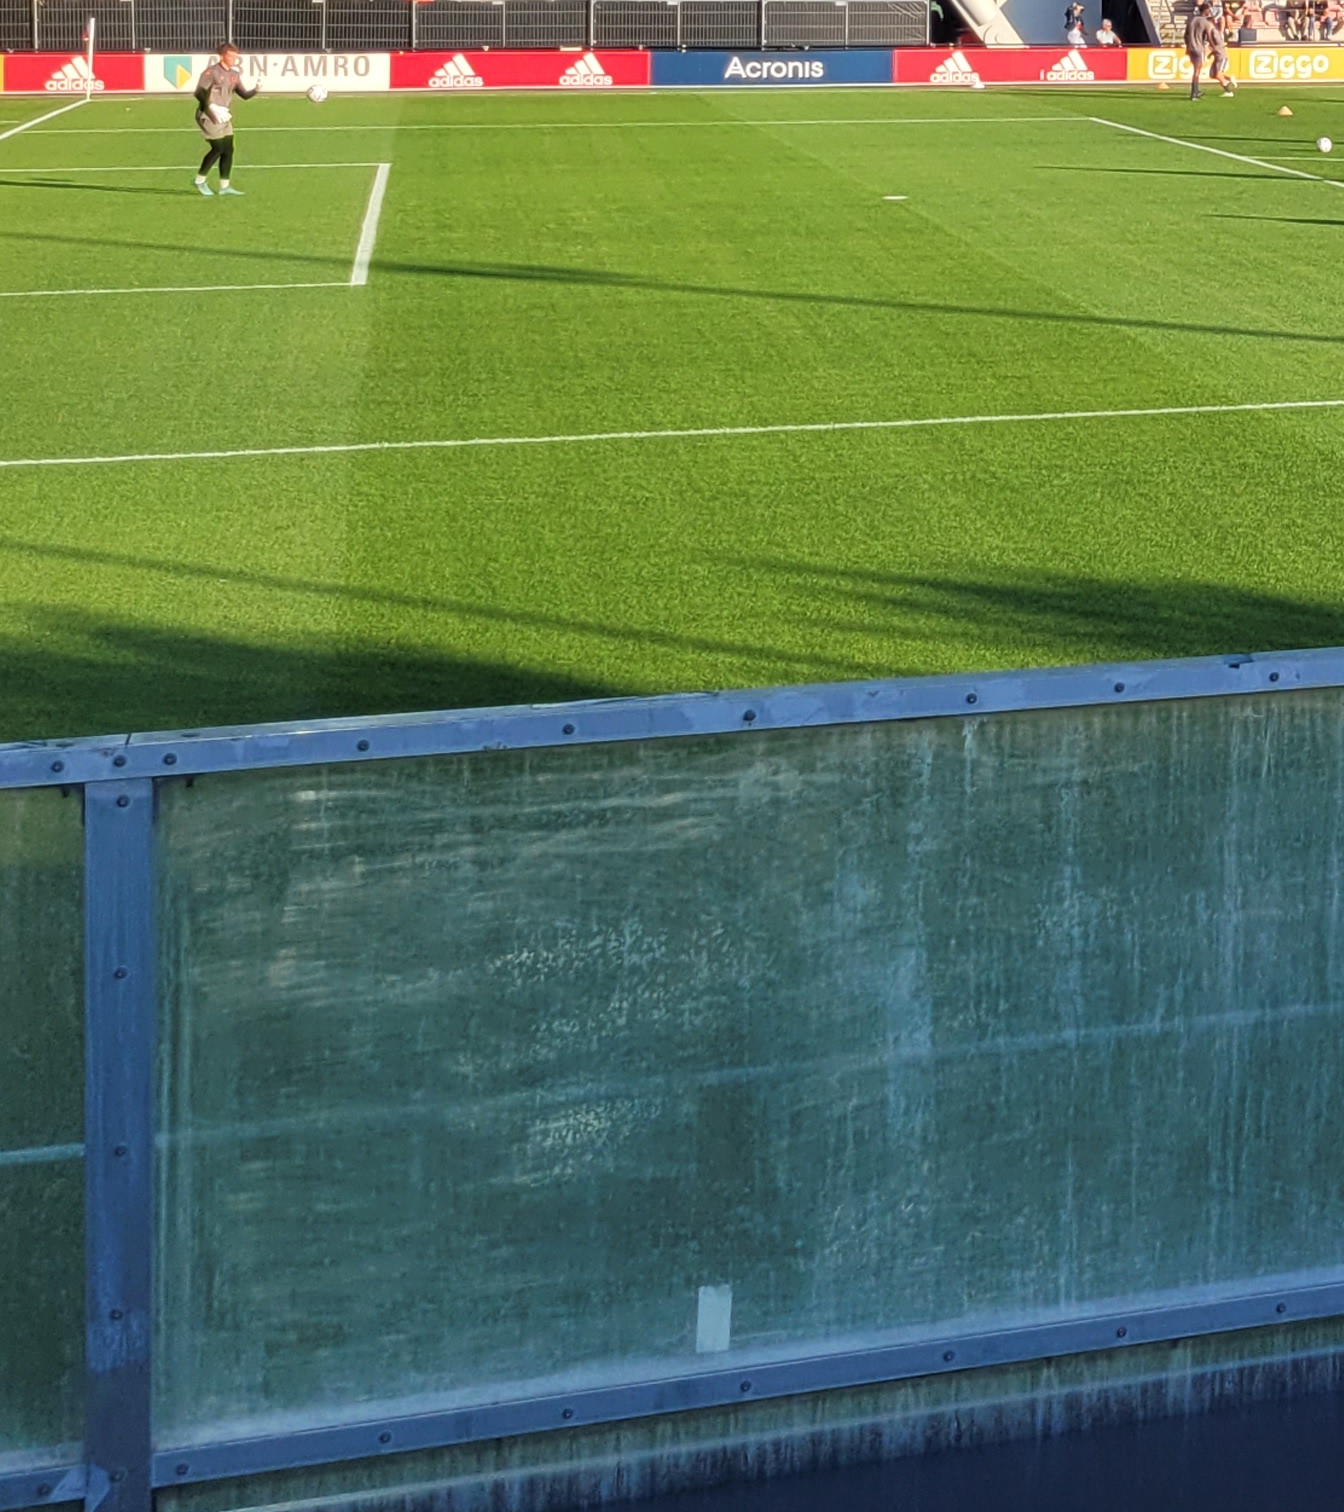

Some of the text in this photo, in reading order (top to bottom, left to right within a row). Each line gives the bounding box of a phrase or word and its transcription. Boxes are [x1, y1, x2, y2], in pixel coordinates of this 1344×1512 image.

[724, 56, 824, 78] Acronis
[428, 74, 484, 87] adidas
[559, 73, 613, 86] adidas
[930, 71, 979, 83] adidas
[1046, 69, 1095, 81] adidas
[45, 78, 105, 91] adidas
